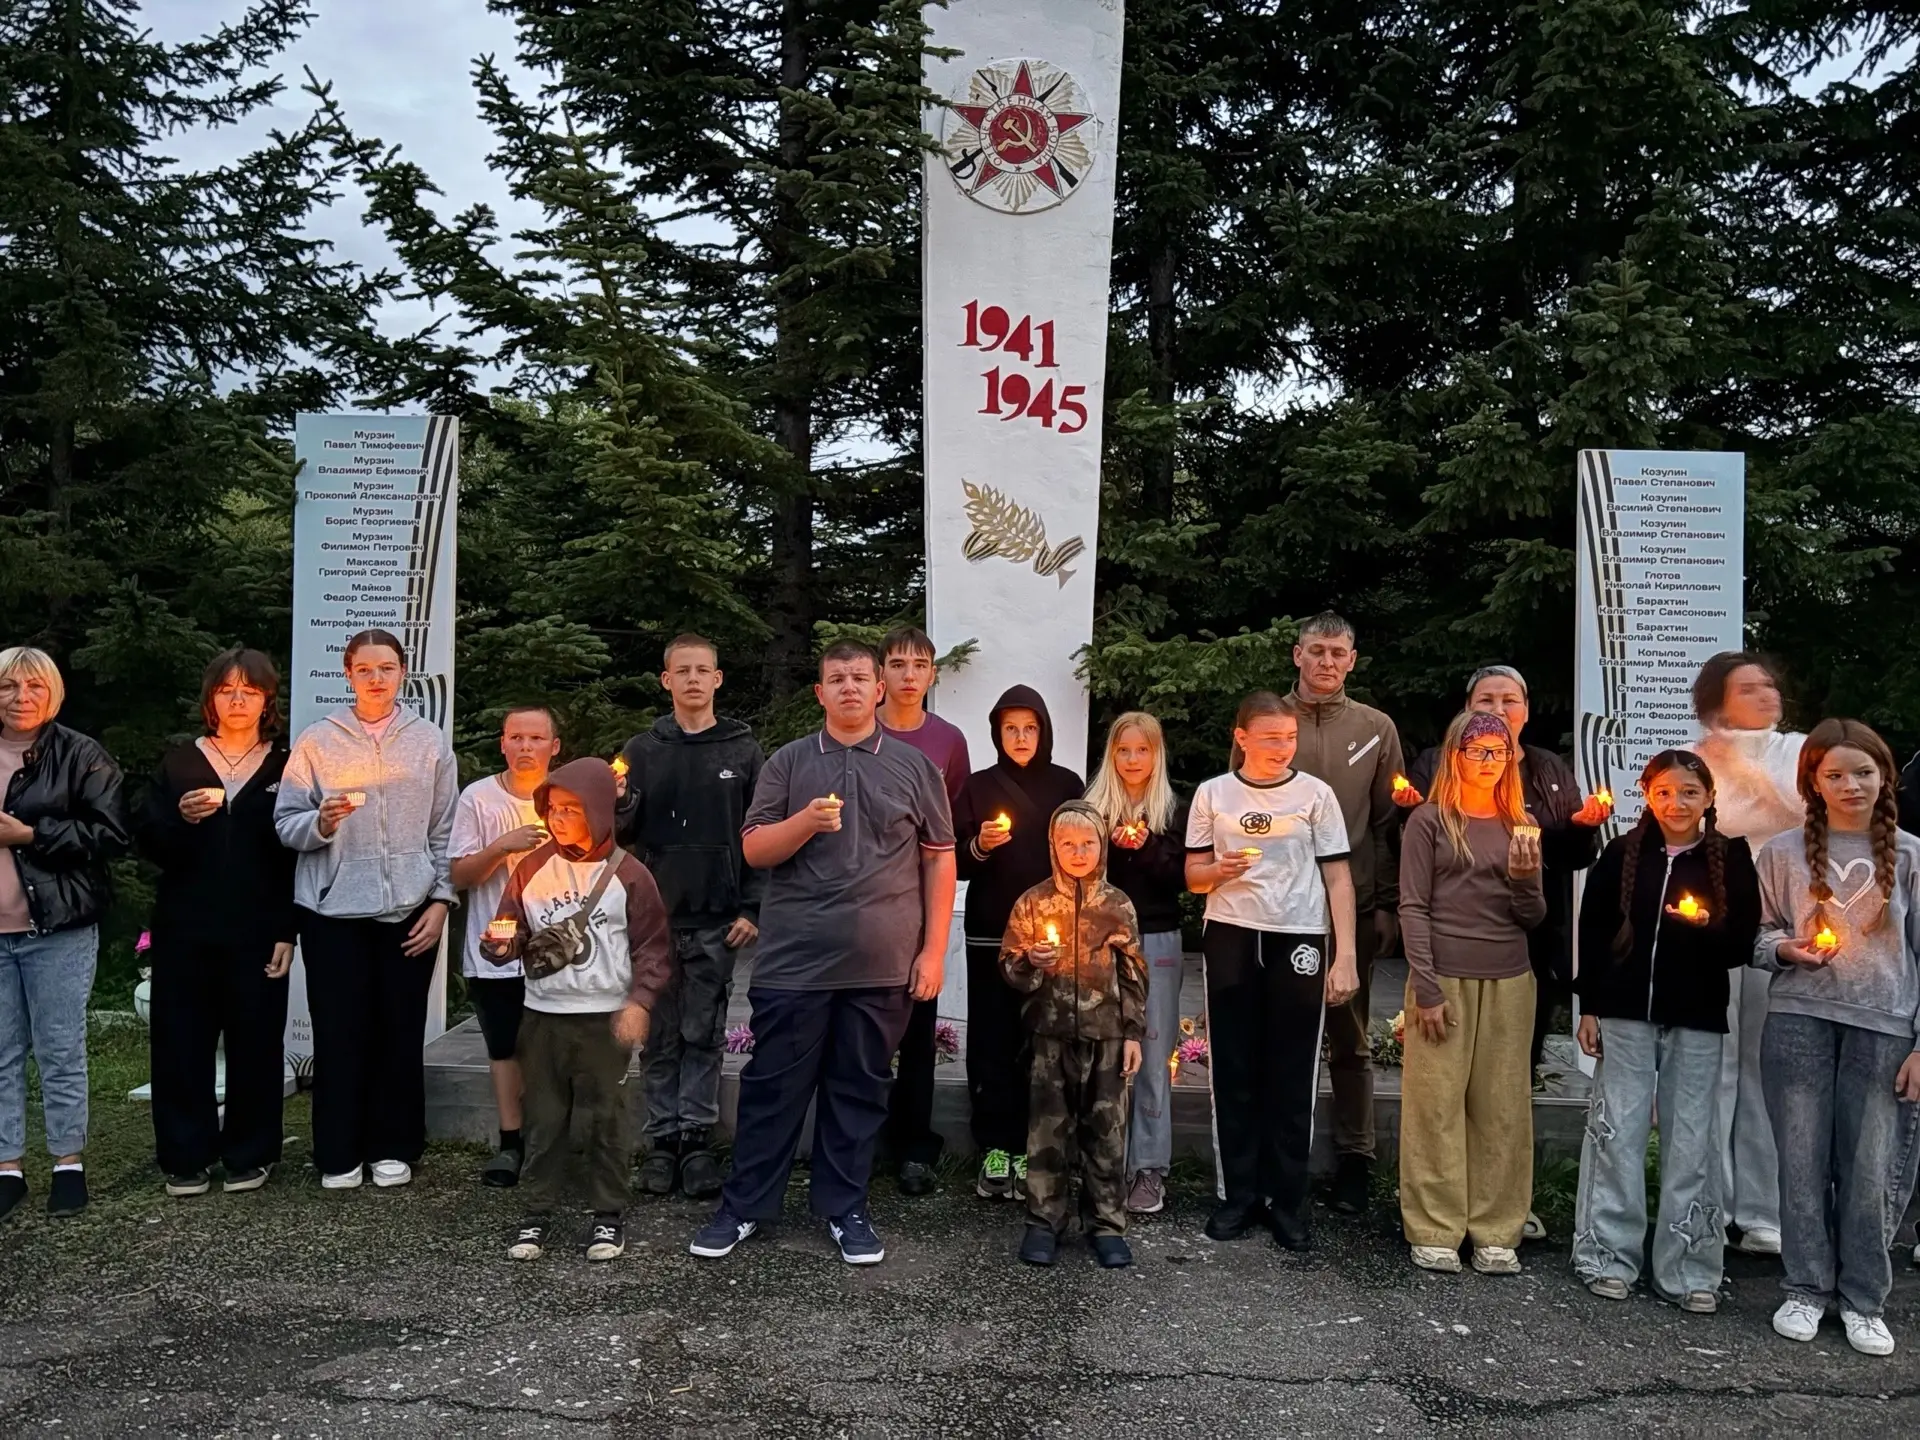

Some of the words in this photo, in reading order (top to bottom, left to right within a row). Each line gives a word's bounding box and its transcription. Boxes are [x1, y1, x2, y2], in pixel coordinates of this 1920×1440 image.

[957, 299, 1060, 368] 1941
[978, 365, 1088, 433] 1945
[354, 431, 395, 439] Мурзин
[360, 441, 424, 450] Тимофеевич
[354, 457, 394, 465] Мурзин
[319, 466, 372, 475] Владимир
[376, 467, 428, 475] Ефимович
[1642, 468, 1687, 477] Козулин
[354, 482, 393, 490] Мурзин
[1651, 479, 1715, 487] Степанович
[305, 491, 356, 500] Прокопий
[360, 493, 441, 501] Александрович
[1641, 494, 1687, 502] Козулин
[353, 508, 393, 516] Мурзин
[1607, 504, 1653, 512] Василий
[1657, 505, 1721, 513] Степанович
[326, 517, 357, 525] Борис
[361, 518, 419, 526] Георгиевич
[1641, 520, 1686, 528] Козулин
[352, 533, 393, 541] Мурзин
[1602, 529, 1657, 538] Владимир
[1661, 531, 1725, 539] Степанович
[321, 543, 369, 551] Филимон
[374, 544, 423, 552] Петрович
[1640, 546, 1686, 554] Козулин
[1602, 555, 1656, 564] Владимир
[1660, 557, 1725, 565] Степанович
[319, 568, 366, 577] Григорий
[1605, 581, 1651, 589] Николай
[1655, 582, 1721, 591] Кириллович
[323, 594, 357, 602] Федор
[1637, 597, 1688, 606] Барахтин
[1600, 608, 1655, 616] Калистрат
[1659, 608, 1726, 617] Самсонович
[311, 619, 364, 628] Митрофан
[1636, 623, 1688, 632] Барахтин
[1607, 633, 1653, 641] Николай
[1657, 634, 1717, 643] Семенович
[1638, 649, 1686, 657] Копылов
[1599, 659, 1654, 668] Владимир
[1636, 675, 1687, 684] Кузнецов
[1617, 685, 1655, 693] Степан
[1660, 686, 1693, 694] Кузьм
[1635, 701, 1688, 710] Ларионов
[1615, 711, 1645, 719] Тихон
[1635, 727, 1688, 736] Ларионов
[1599, 737, 1652, 745] Афанасий
